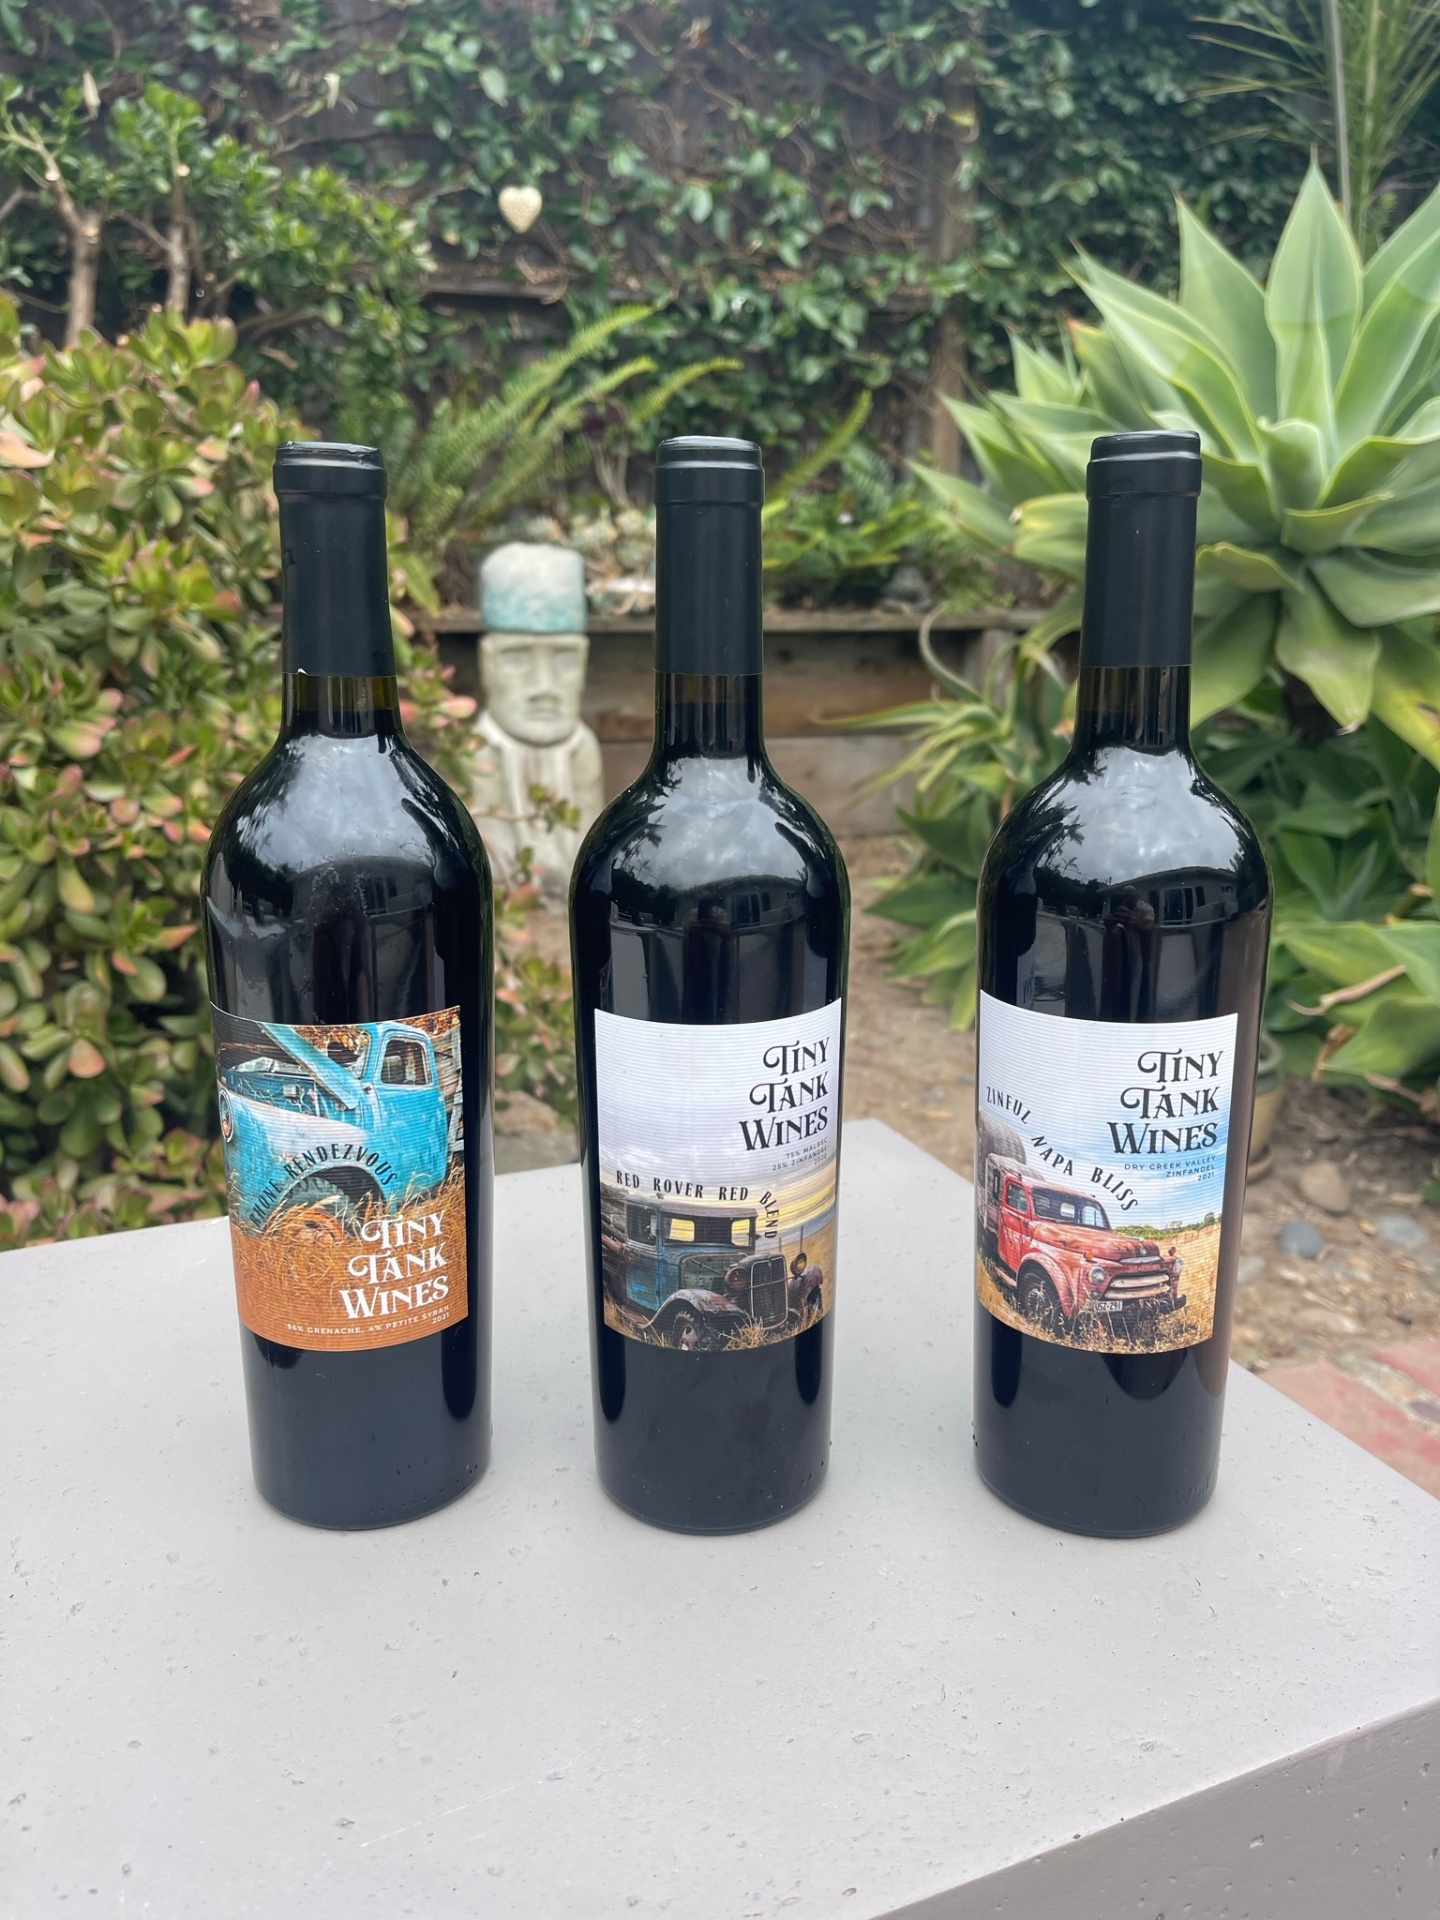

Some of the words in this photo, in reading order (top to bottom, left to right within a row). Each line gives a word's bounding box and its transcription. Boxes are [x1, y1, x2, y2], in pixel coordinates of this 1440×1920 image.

[763, 1037, 829, 1076] TINY
[1137, 1048, 1224, 1083] TINY
[749, 1071, 828, 1113] TANK
[1120, 1085, 1220, 1119] TANK
[738, 1106, 828, 1151] WINES
[1106, 1122, 1218, 1154] WINES
[785, 1151, 800, 1159] 75%
[803, 1137, 828, 1153] MALBEC
[986, 1086, 1031, 1124] ZINFUL
[1031, 1136, 1073, 1176] NAPA
[1091, 1167, 1138, 1211] BLISS
[1149, 1162, 1181, 1170] CREEK
[1185, 1155, 1216, 1167] VALLEY
[249, 1178, 283, 1227] RHONE
[283, 1143, 398, 1186] RENDEZVOUS
[1165, 1164, 1215, 1178] ZINFANDEL
[1197, 1172, 1215, 1181] 2021
[616, 1169, 640, 1189] RED
[653, 1177, 704, 1198] ROVER
[718, 1186, 748, 1201] RED
[759, 1191, 779, 1239] BLEND
[361, 1210, 446, 1249] TINY
[348, 1242, 447, 1284] TANK
[338, 1275, 449, 1319] WINES
[307, 1326, 364, 1335] GRENACHE,
[368, 1324, 382, 1332] 4%
[386, 1316, 418, 1330] PETITE
[422, 1305, 449, 1320] SYRAH
[432, 1313, 449, 1325] 2021
